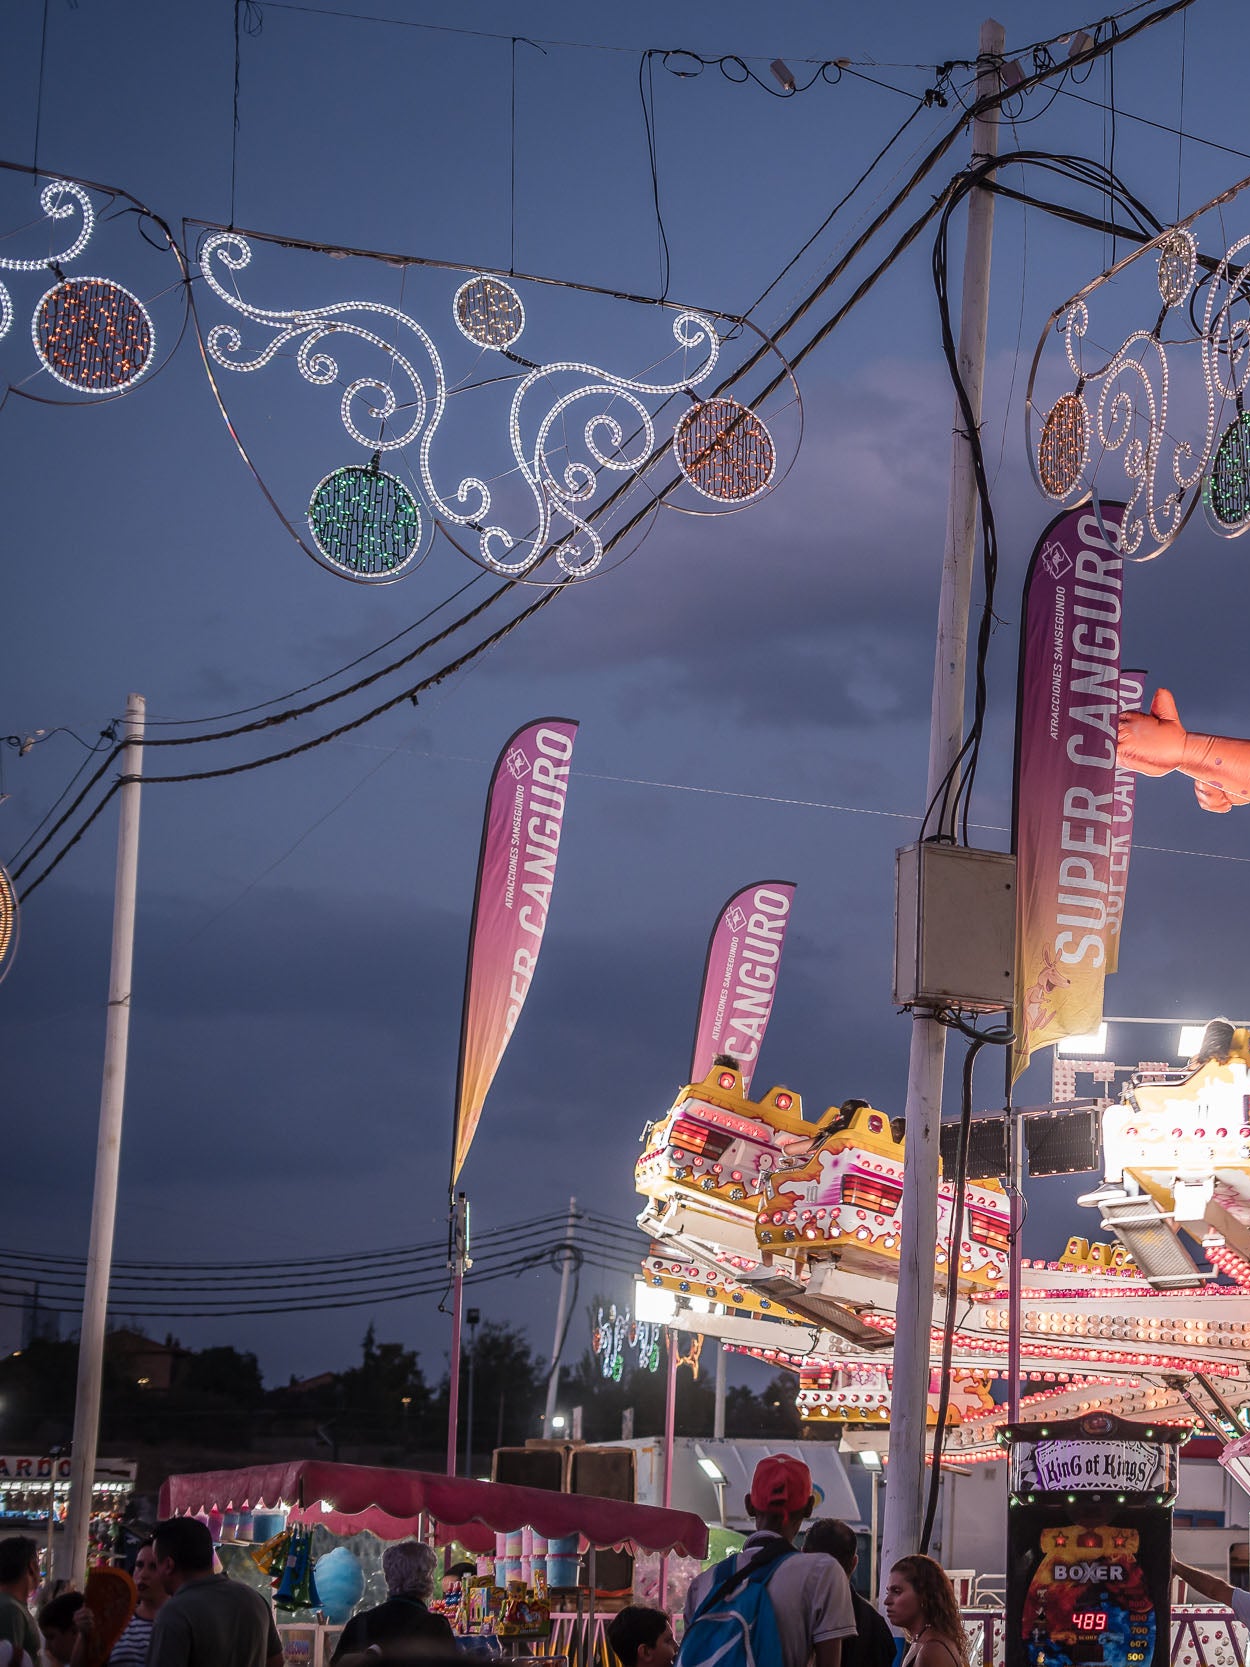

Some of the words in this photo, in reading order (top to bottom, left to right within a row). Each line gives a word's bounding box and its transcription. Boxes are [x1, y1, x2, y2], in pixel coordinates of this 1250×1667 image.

[1054, 585, 1066, 661] SANSEGUNDO
[1065, 514, 1123, 770] CANGURO
[1050, 664, 1063, 741] ATRACCIONES
[511, 784, 525, 846] SANSEGUNDO
[519, 728, 573, 938] CANGURO
[505, 847, 519, 909] ATRACCIONES
[1055, 786, 1113, 968] SUPER
[711, 988, 729, 1041] ATRACCIONES
[723, 936, 739, 988] SANSEGUNDO
[724, 888, 790, 1062] CANGURO
[1085, 1454, 1100, 1476] of
[1054, 1562, 1124, 1583] BOXER
[1072, 1613, 1107, 1630] 489
[1127, 1652, 1144, 1660] 500
